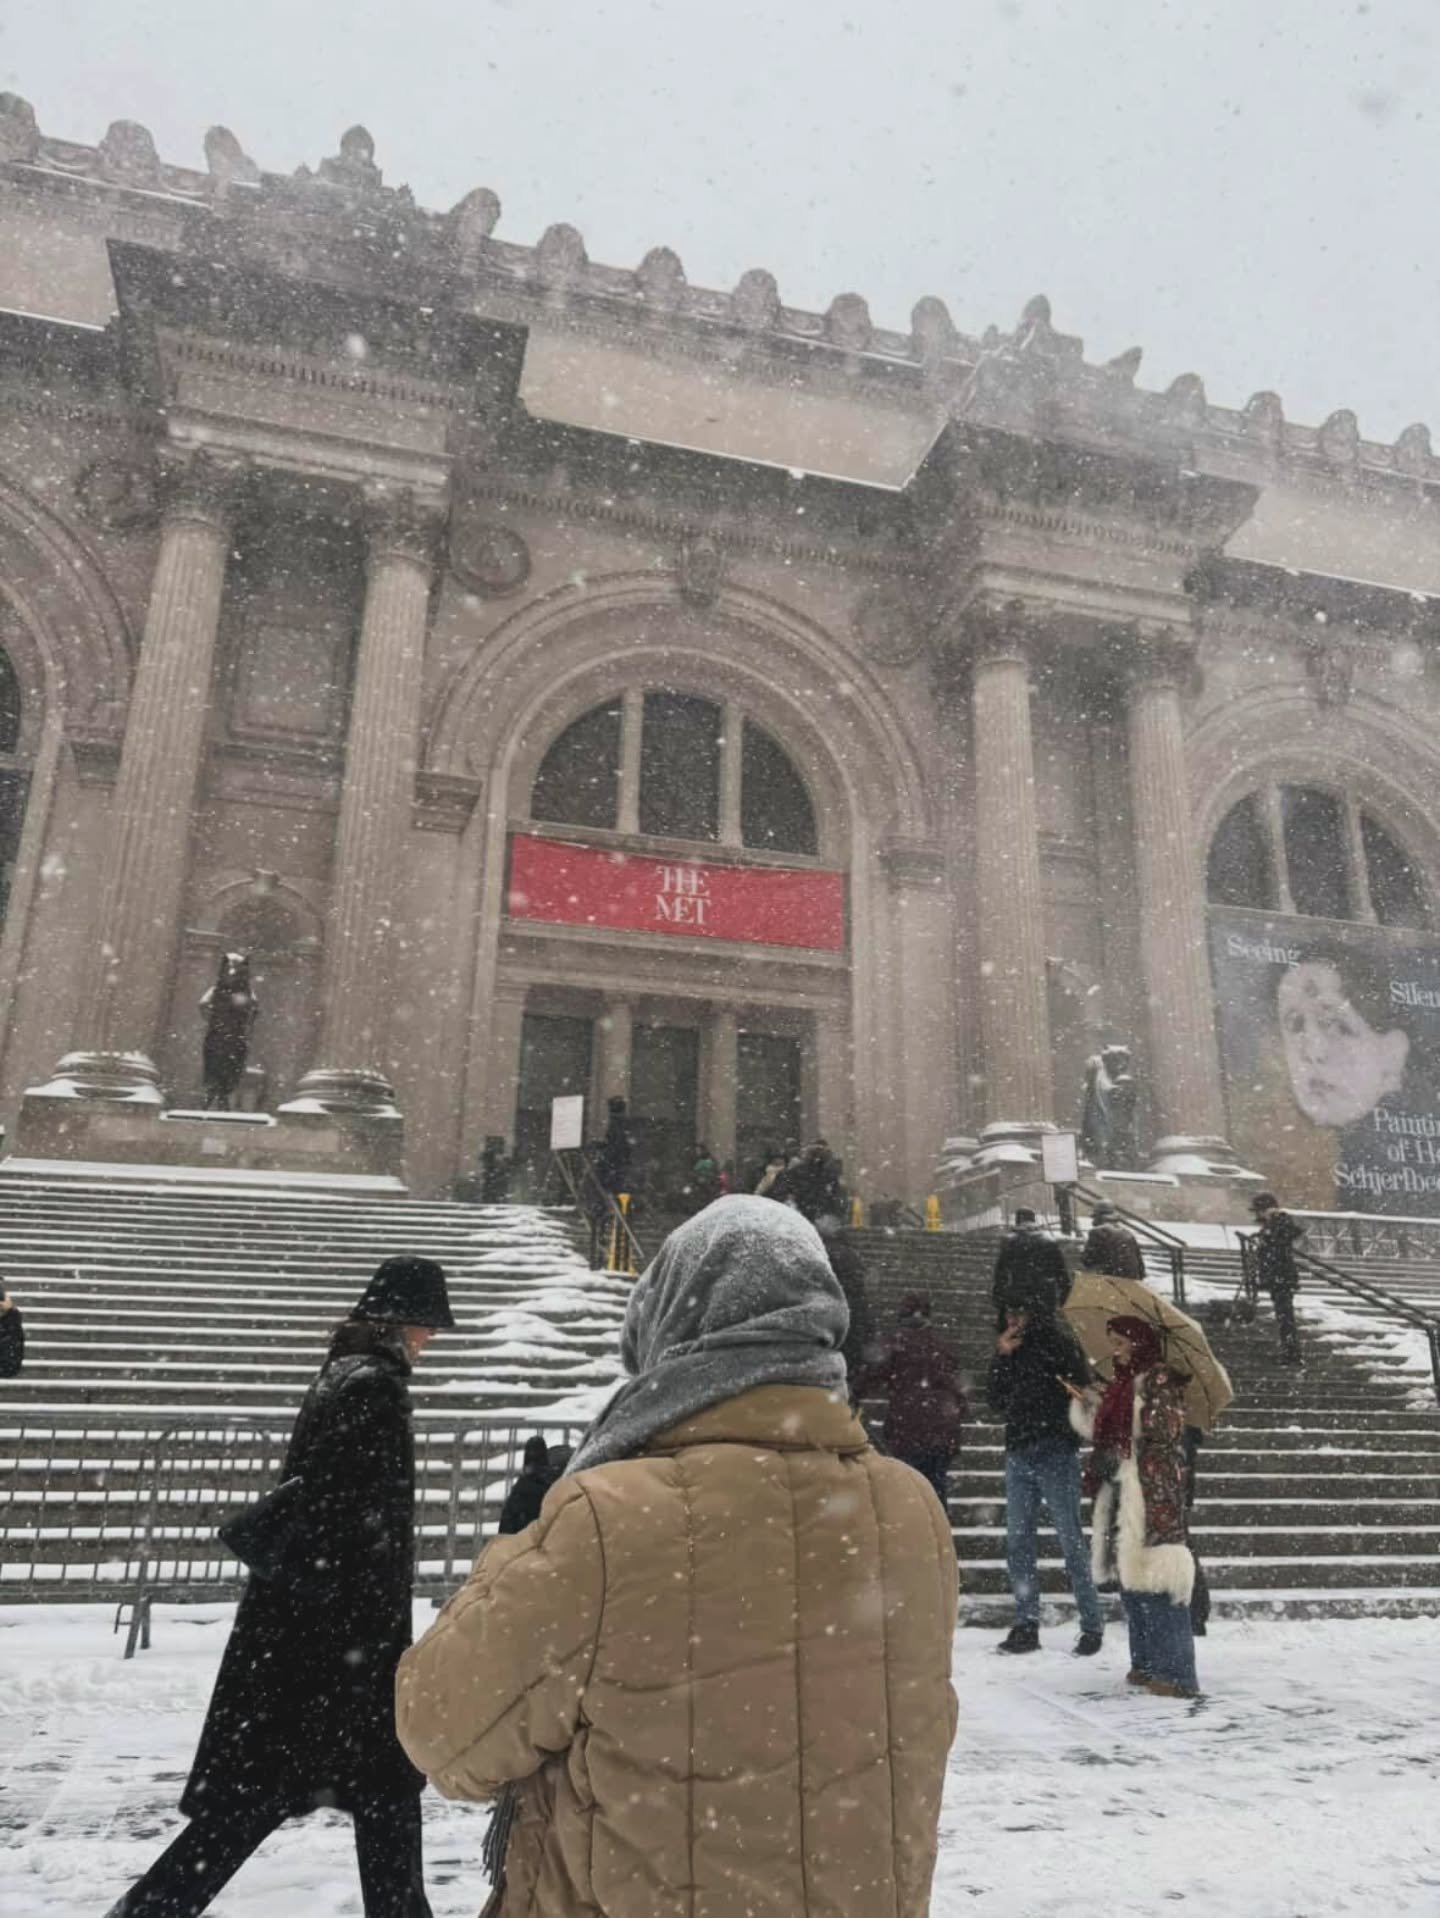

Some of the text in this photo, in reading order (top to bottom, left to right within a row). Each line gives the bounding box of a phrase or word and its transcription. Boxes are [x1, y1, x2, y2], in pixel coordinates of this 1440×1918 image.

[656, 865, 710, 896] THE
[656, 894, 712, 925] MET
[1227, 935, 1301, 968] Seeing
[1387, 1138, 1409, 1162] of
